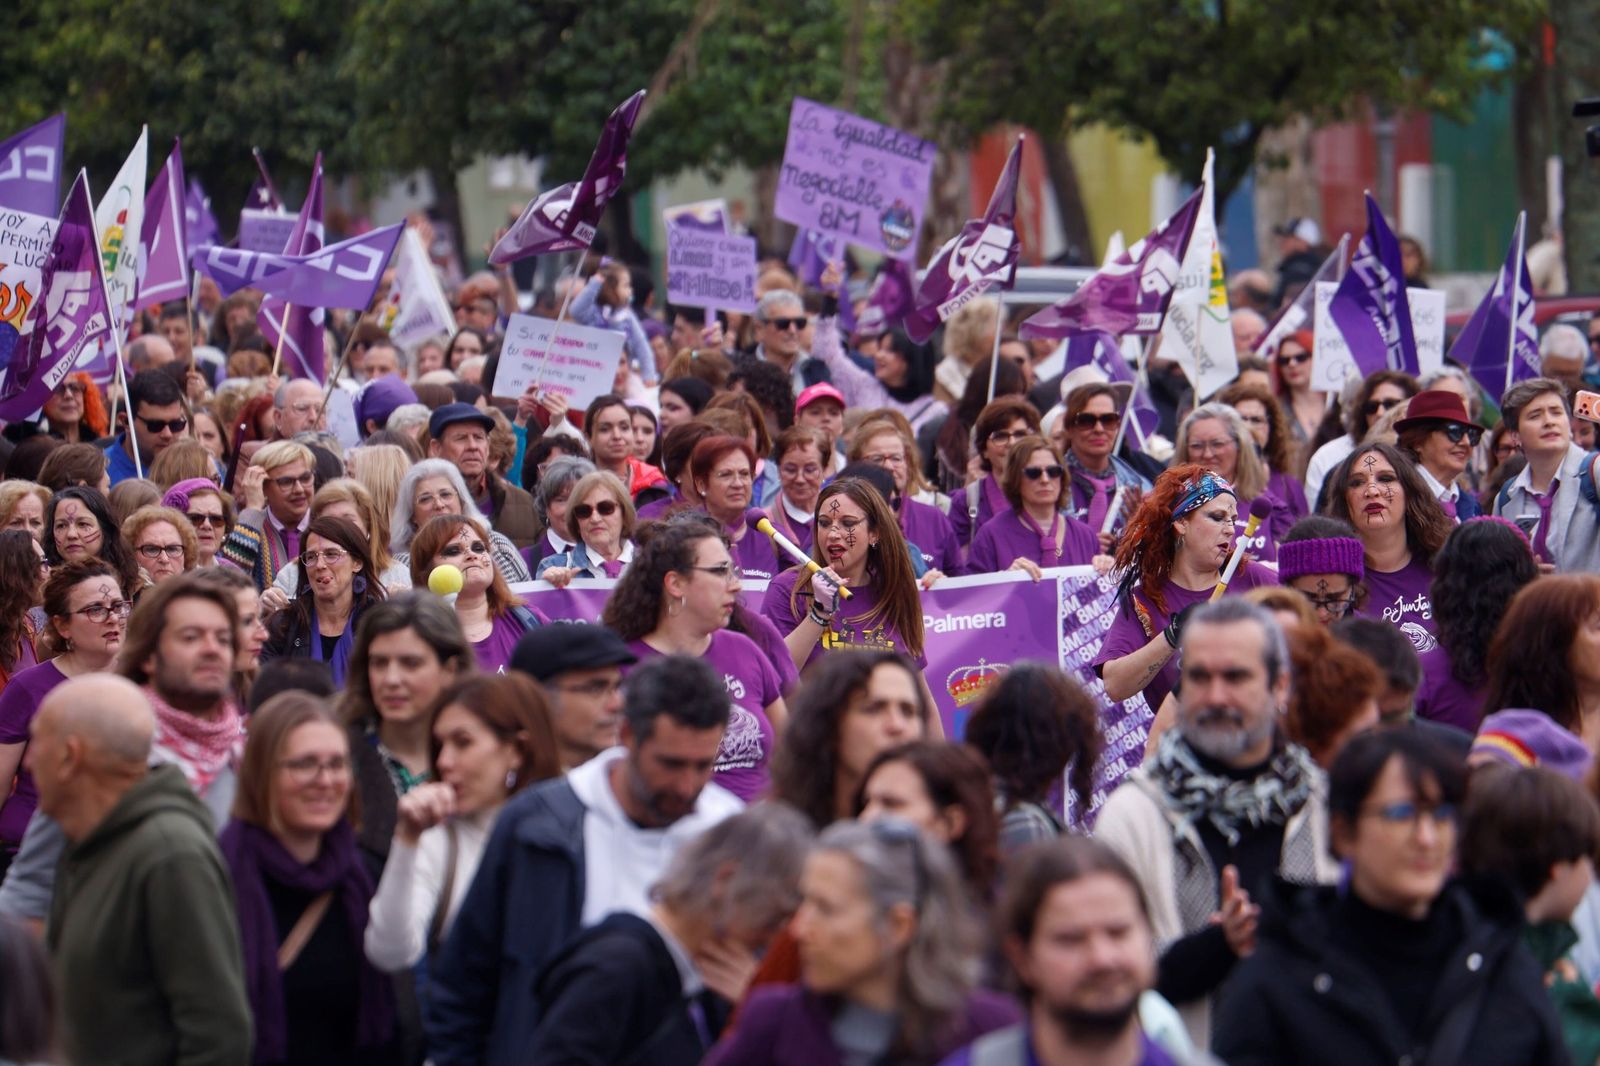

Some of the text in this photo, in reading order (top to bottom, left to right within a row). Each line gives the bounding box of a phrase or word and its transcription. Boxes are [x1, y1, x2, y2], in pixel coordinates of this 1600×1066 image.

[38, 221, 51, 238] A
[818, 202, 860, 236] 8M
[923, 611, 1006, 633] Palmera
[1077, 600, 1102, 624] 8M
[1104, 721, 1128, 745] 8M
[1123, 726, 1148, 750] 8M
[1104, 757, 1129, 781] 8M
